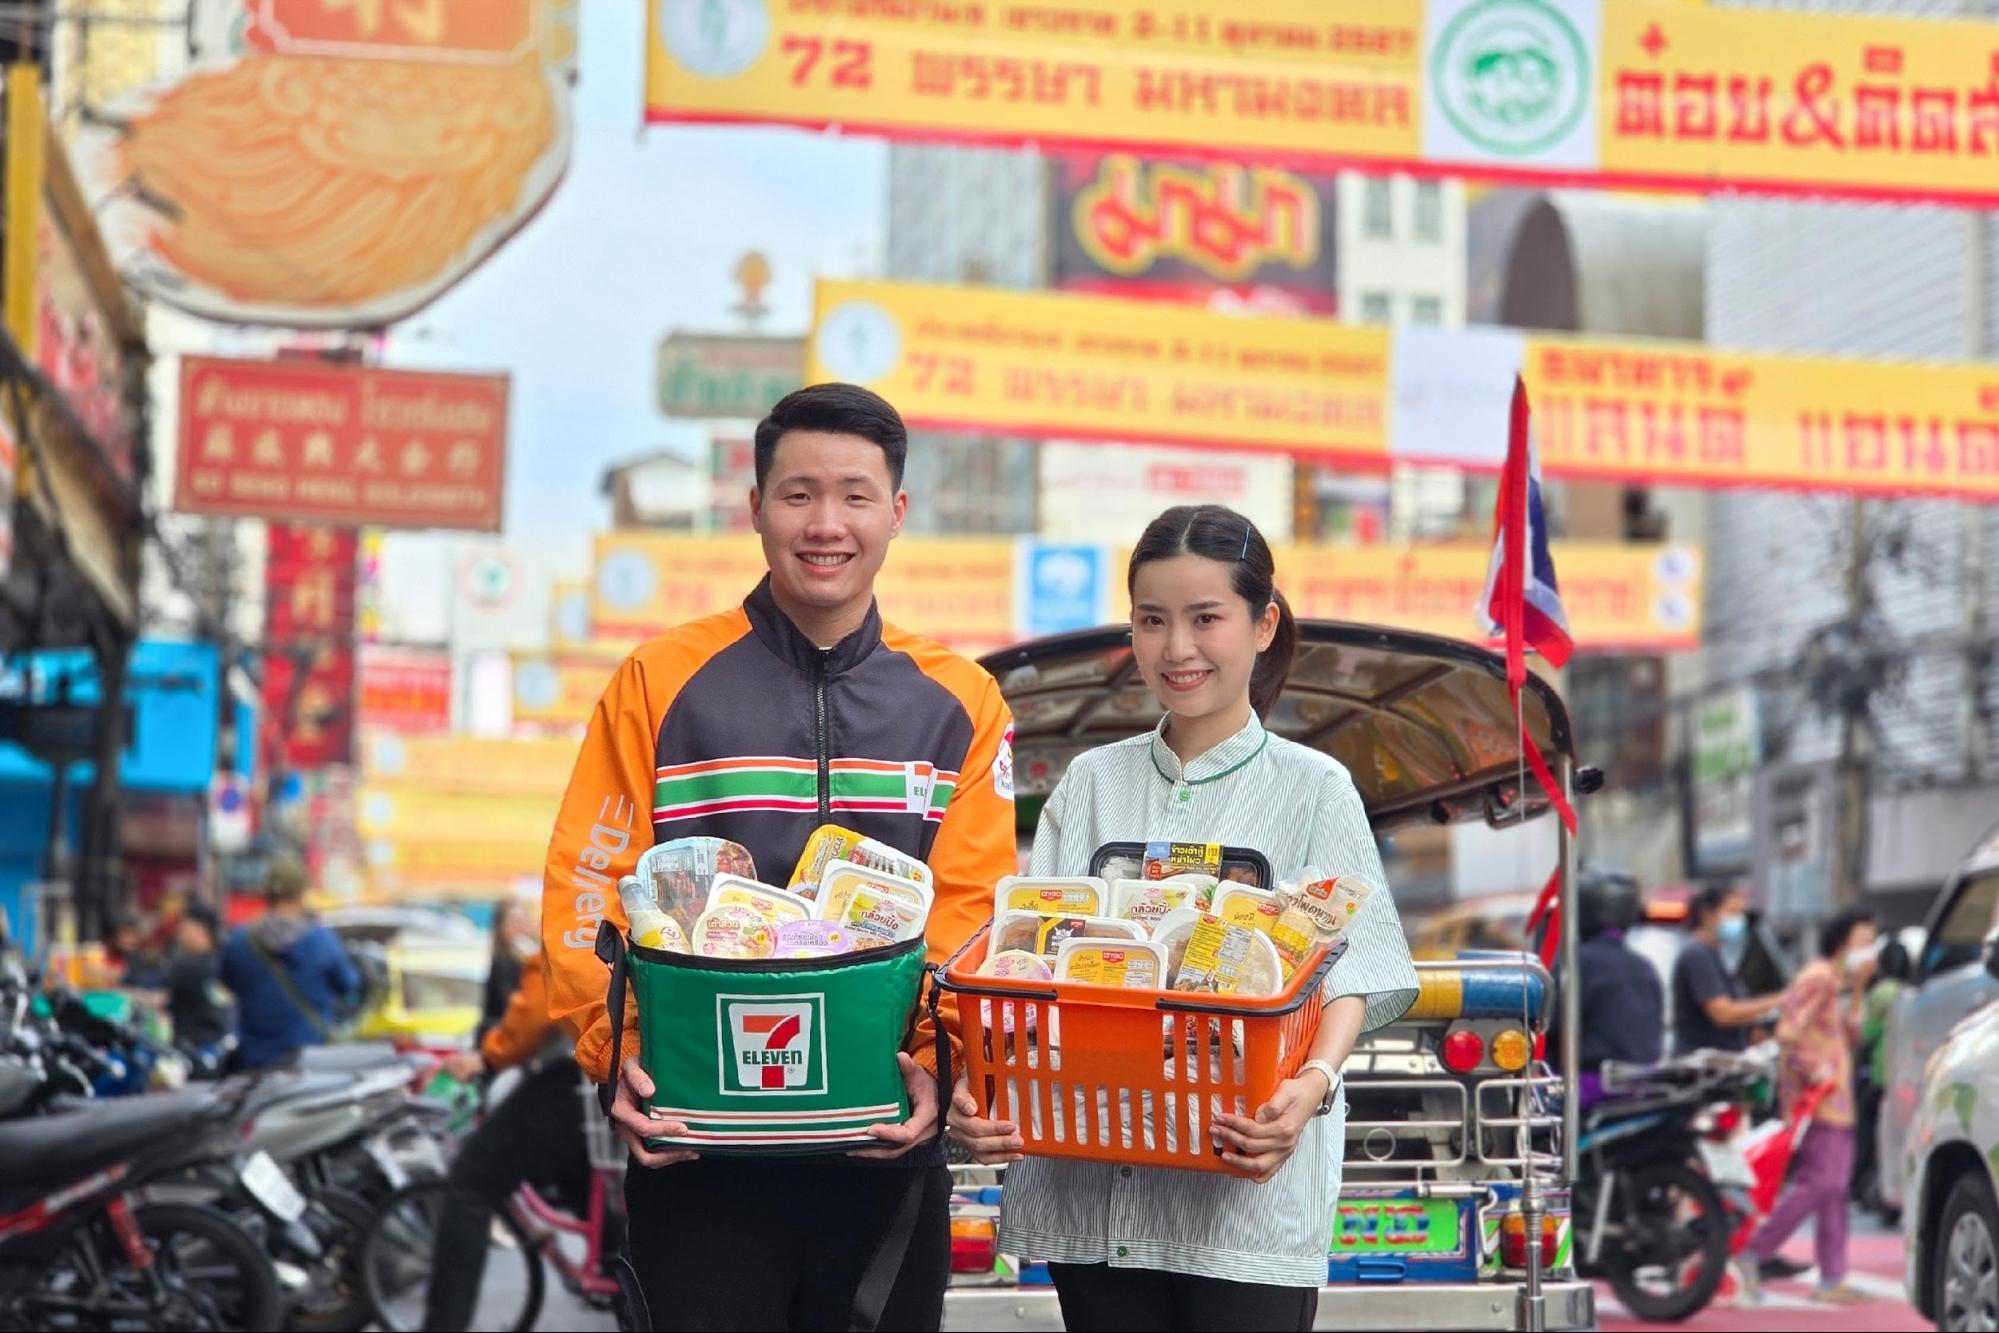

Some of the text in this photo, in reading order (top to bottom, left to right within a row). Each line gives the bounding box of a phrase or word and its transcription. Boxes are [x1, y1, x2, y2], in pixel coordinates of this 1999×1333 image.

[781, 34, 873, 89] 72
[911, 49, 1101, 106] พรรษา
[1131, 902, 1171, 914] กล้วยปิ้
